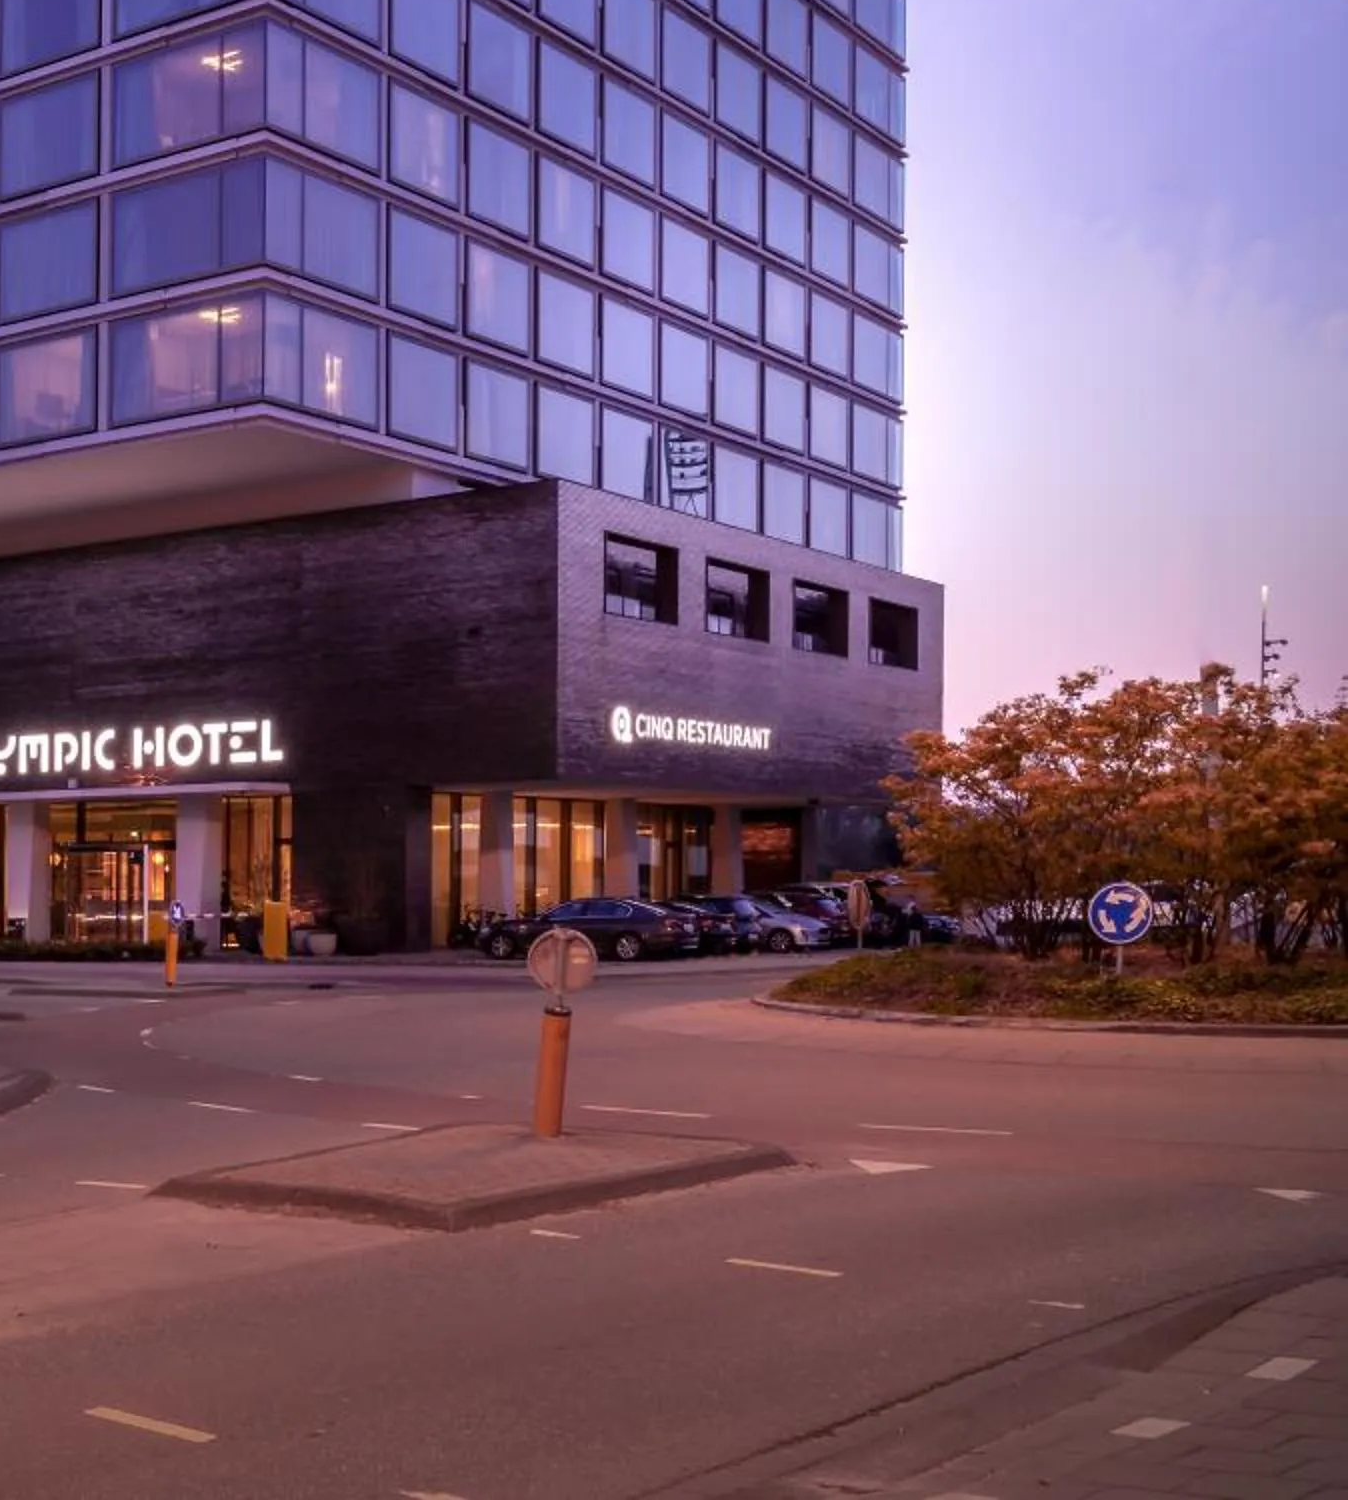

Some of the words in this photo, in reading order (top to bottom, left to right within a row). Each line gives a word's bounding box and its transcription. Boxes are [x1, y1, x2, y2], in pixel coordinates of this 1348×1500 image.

[133, 719, 283, 769] HOTEL
[636, 713, 674, 740] CINQ
[677, 718, 771, 750] RESTAURANT
